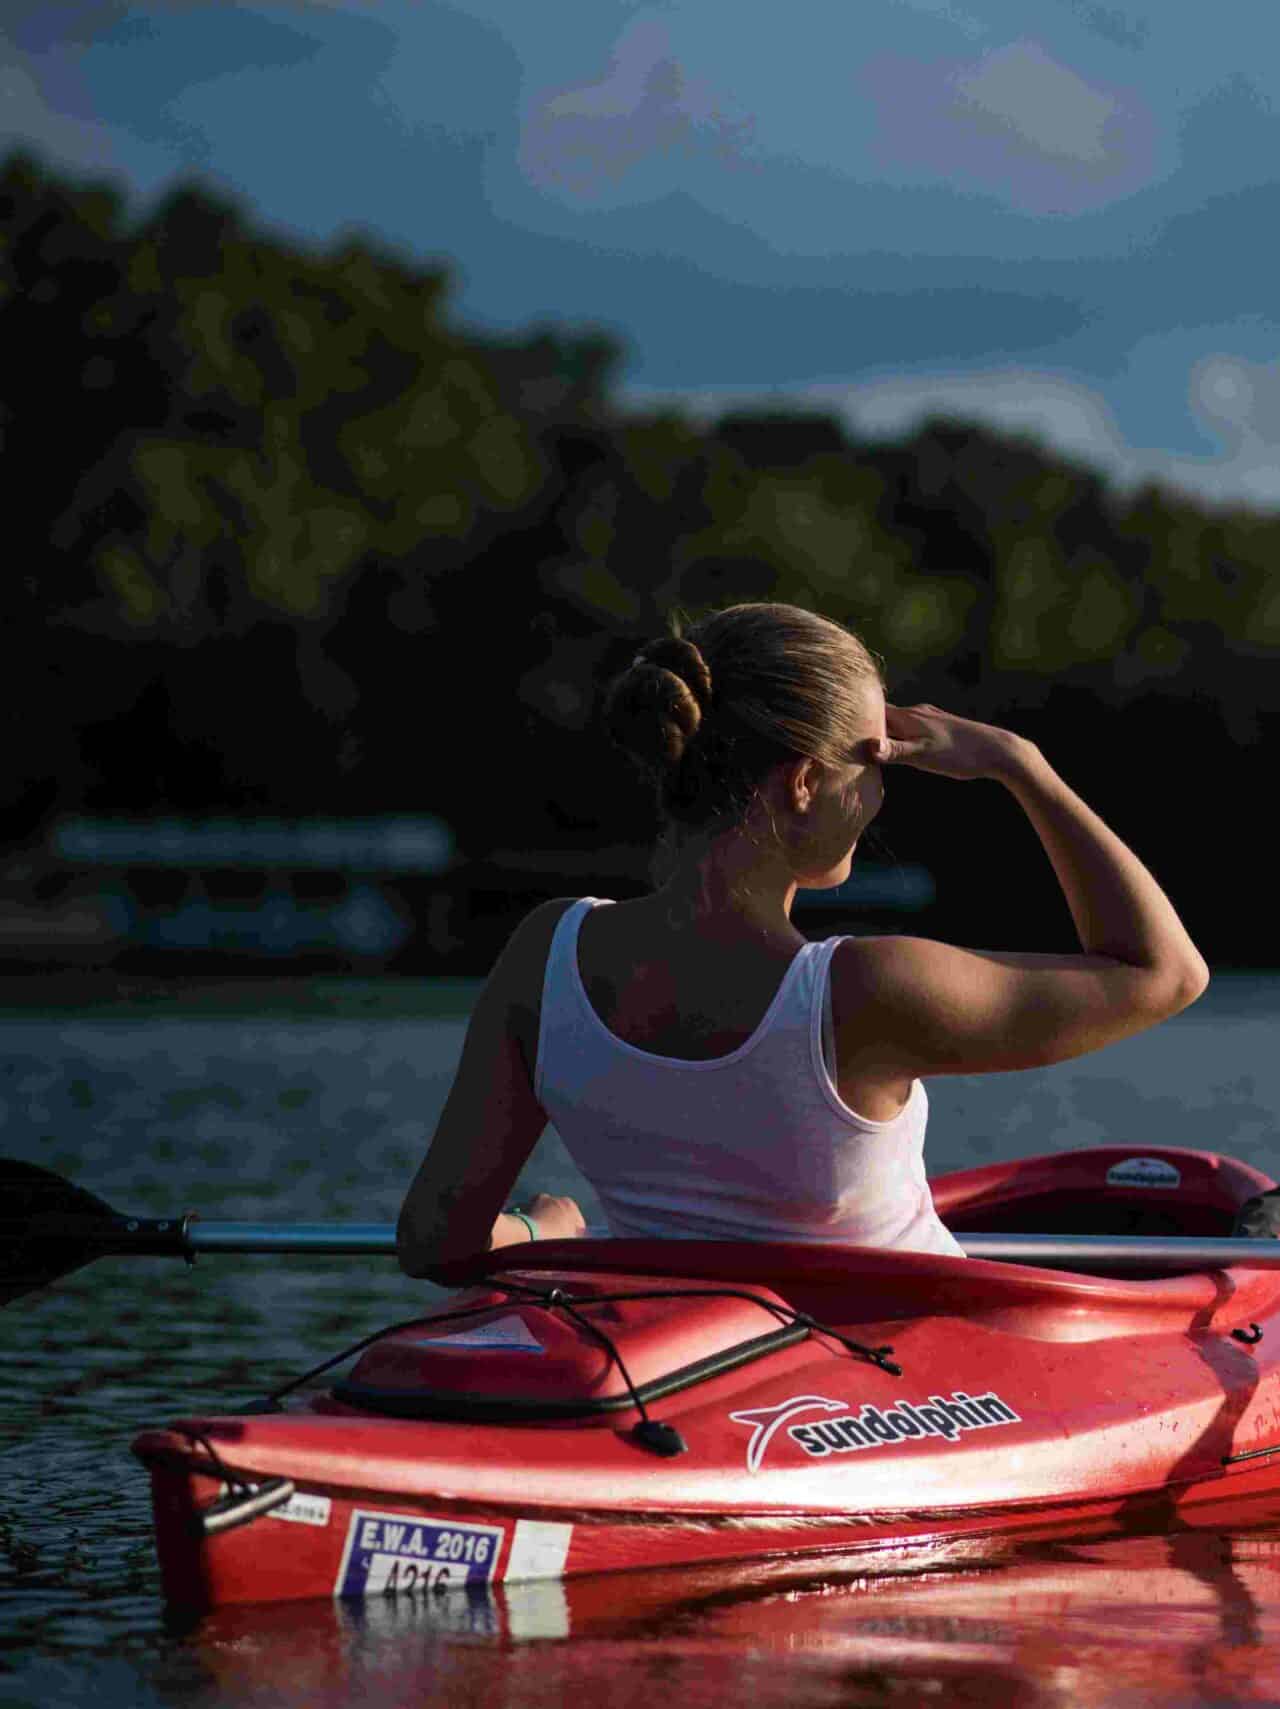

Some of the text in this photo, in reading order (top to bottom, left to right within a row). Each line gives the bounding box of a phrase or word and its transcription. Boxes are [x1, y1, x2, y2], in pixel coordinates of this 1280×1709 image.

[789, 1393, 1019, 1455] sundolphin
[360, 1520, 491, 1563] E.W.A. 2016
